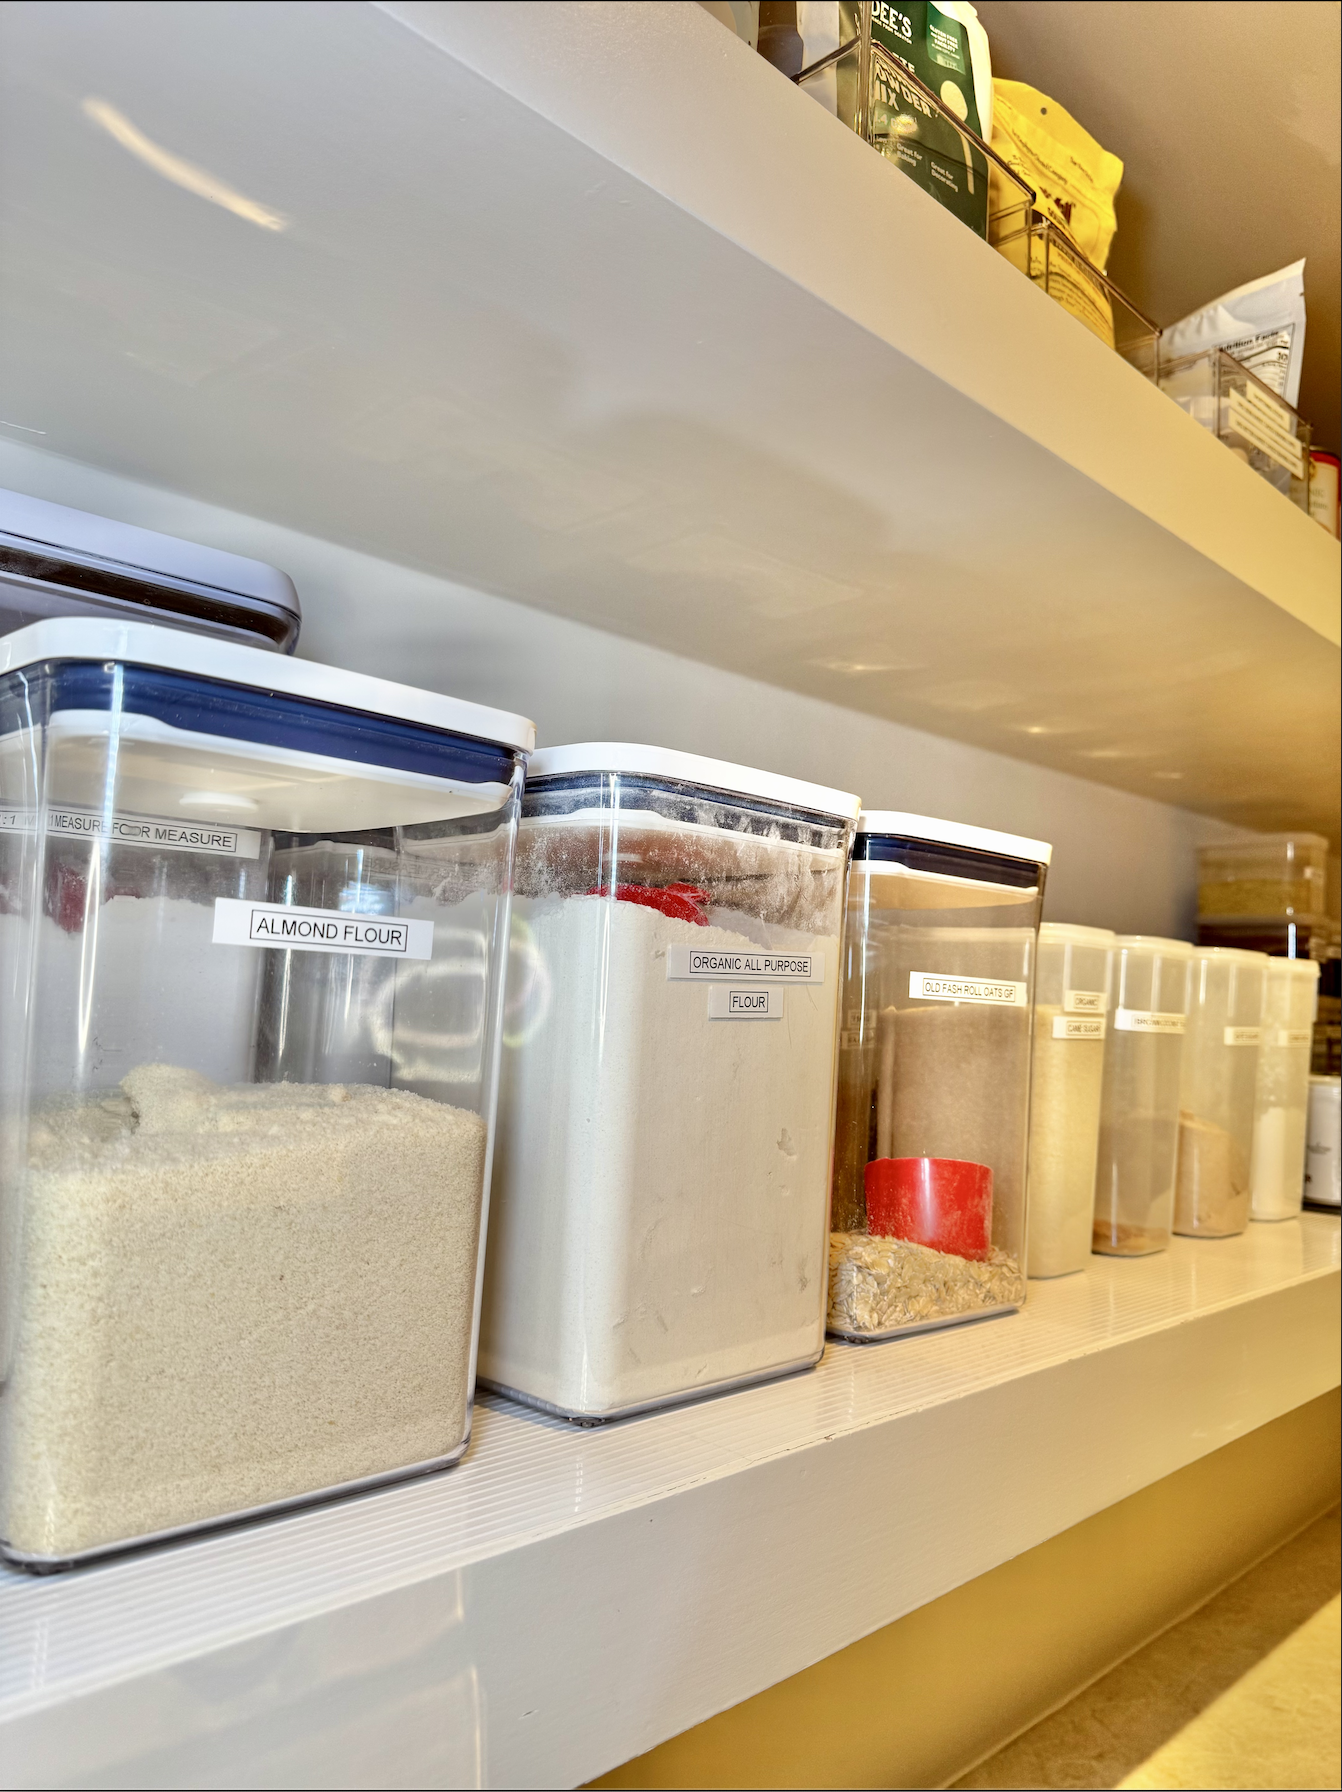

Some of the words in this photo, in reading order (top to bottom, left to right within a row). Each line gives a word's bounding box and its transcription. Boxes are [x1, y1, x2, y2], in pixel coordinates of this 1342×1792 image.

[55, 815, 109, 833] MEASURE
[155, 827, 233, 848] MEASURE
[256, 917, 338, 940] ALMOND
[343, 924, 403, 945] FLOUR
[693, 956, 742, 971] ORGANIC
[744, 957, 762, 971] ALL
[764, 958, 809, 973] PURPOSE
[925, 982, 940, 993] OLD
[942, 983, 962, 995] FASH
[964, 985, 982, 997] ROLL
[984, 987, 1003, 998] OATS
[1004, 988, 1014, 999] GF
[732, 995, 766, 1009] FLOUR
[1075, 997, 1097, 1007] ORGANIC
[1067, 1024, 1082, 1033] CANE
[1082, 1024, 1101, 1033] SUGAR
